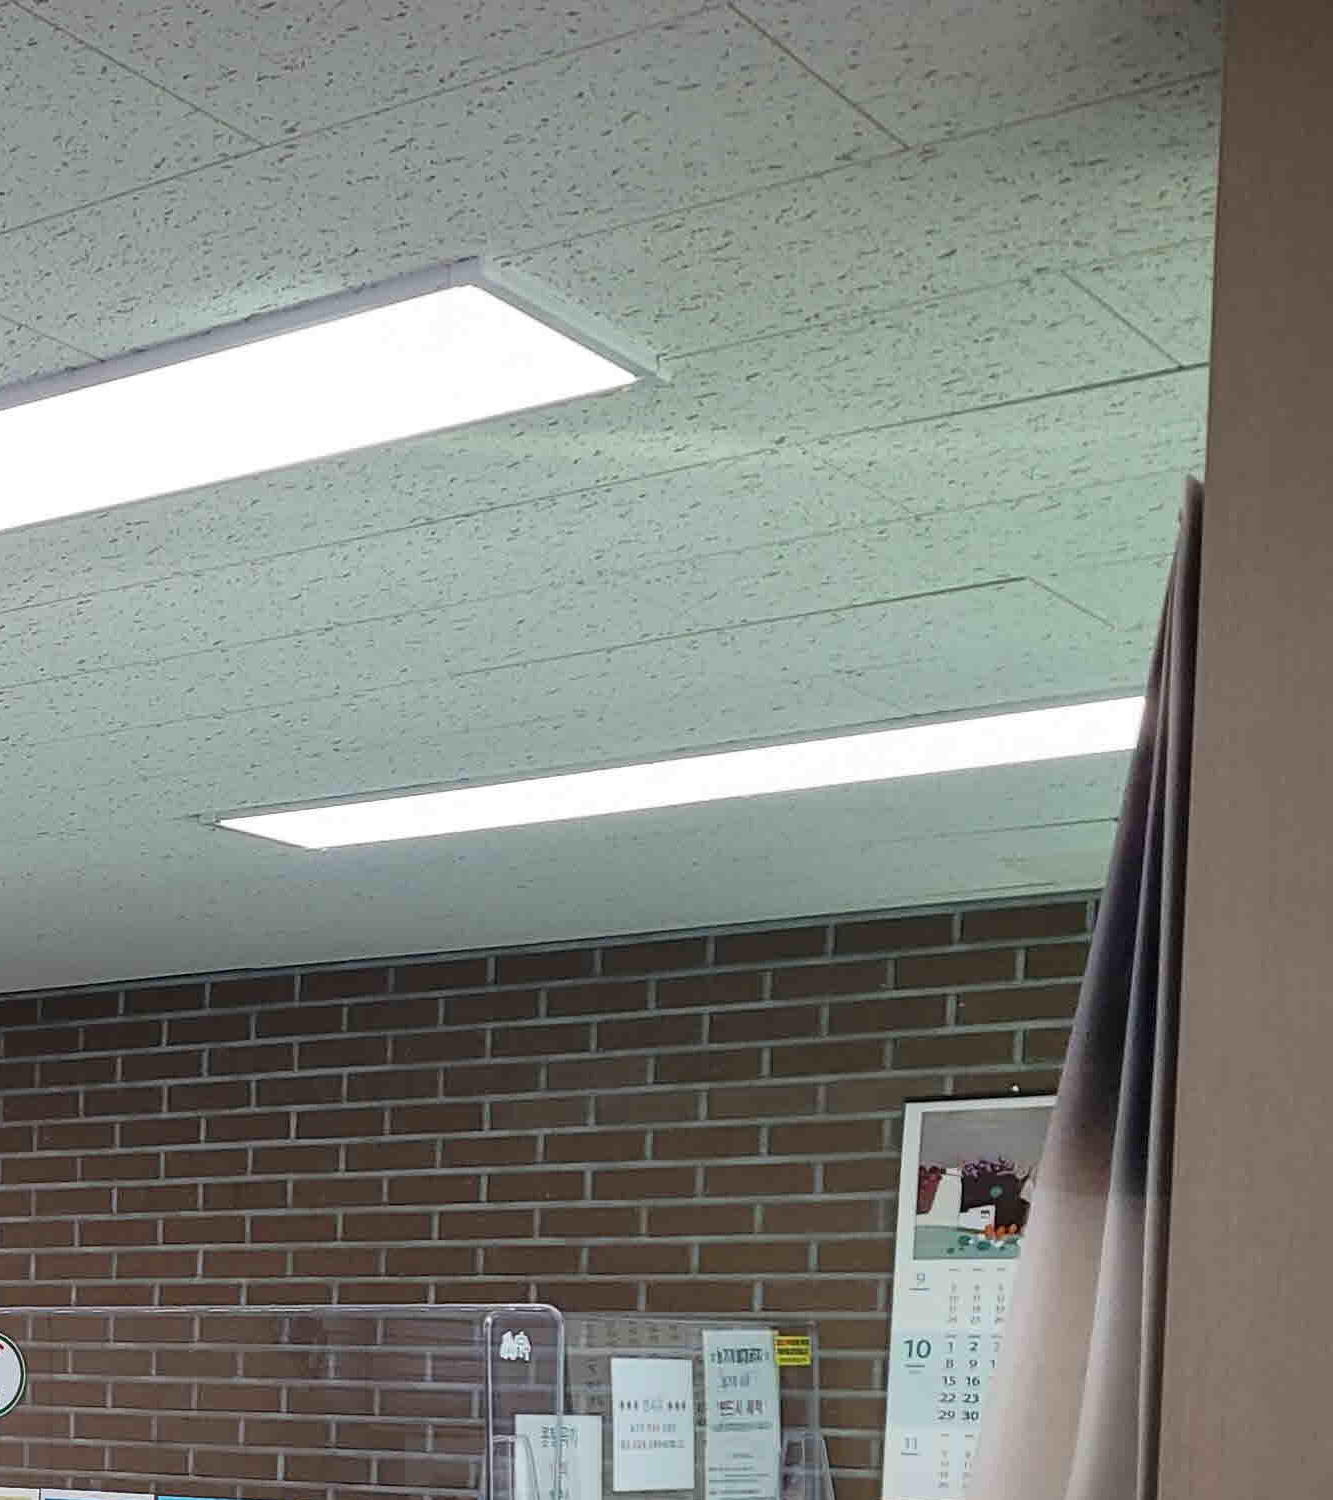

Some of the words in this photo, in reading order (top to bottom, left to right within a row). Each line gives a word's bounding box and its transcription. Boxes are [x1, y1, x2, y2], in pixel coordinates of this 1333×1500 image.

[903, 1338, 932, 1360] 10
[970, 1341, 979, 1353] 2
[945, 1359, 954, 1370] 8
[968, 1359, 978, 1370] 9
[942, 1375, 957, 1387] 15
[965, 1376, 981, 1387] 16
[938, 1392, 956, 1404] 22
[962, 1392, 981, 1404] 23
[937, 1409, 956, 1421] 29
[961, 1410, 980, 1422] 30
